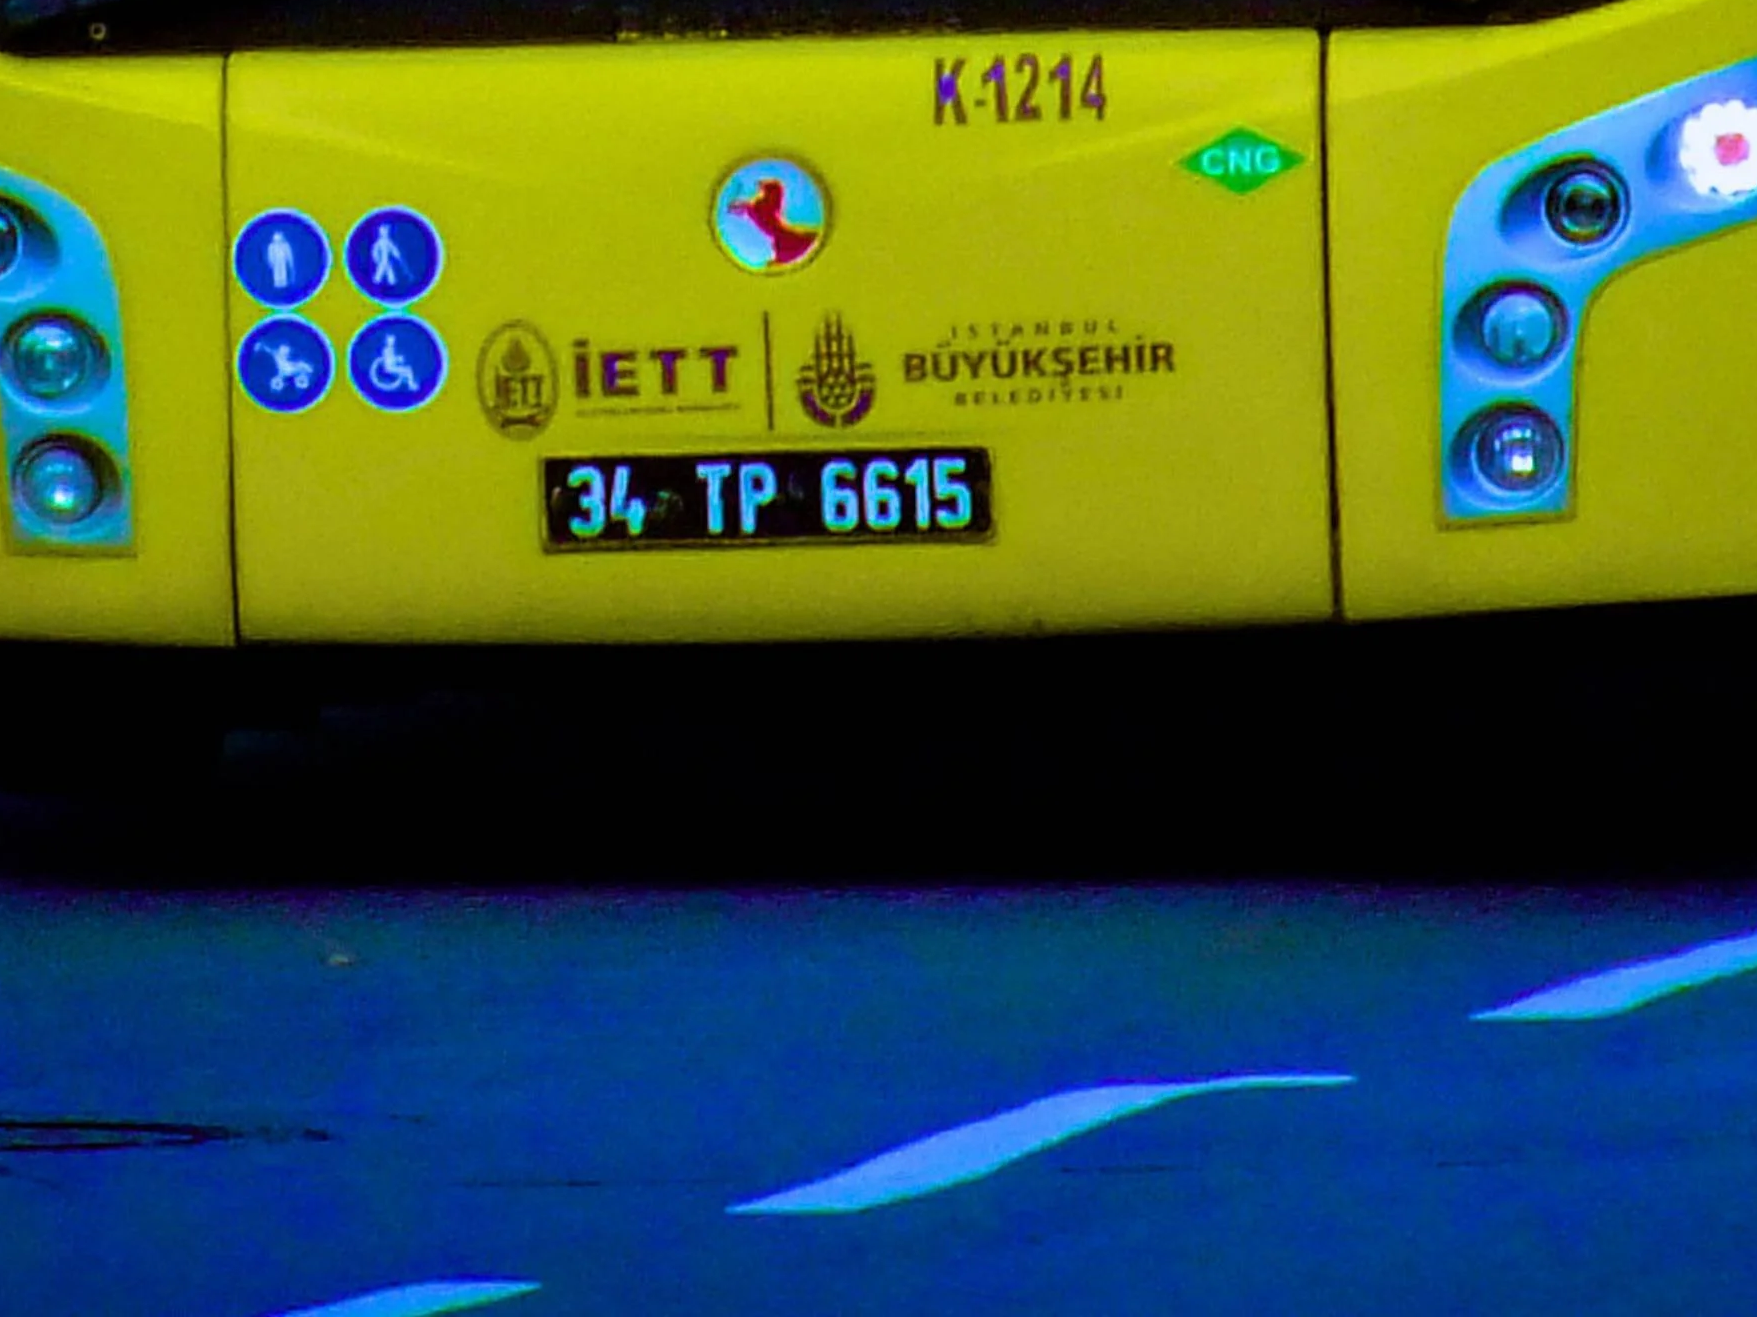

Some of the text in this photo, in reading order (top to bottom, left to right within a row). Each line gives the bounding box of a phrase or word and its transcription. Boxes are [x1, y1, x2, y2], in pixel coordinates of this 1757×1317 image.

[933, 52, 1106, 126] K-1214
[1200, 144, 1282, 177] CNG
[572, 338, 739, 399] İETT
[903, 334, 1175, 388] BÜYÜKŞEHİR
[566, 456, 973, 539] 34 TP 6615
